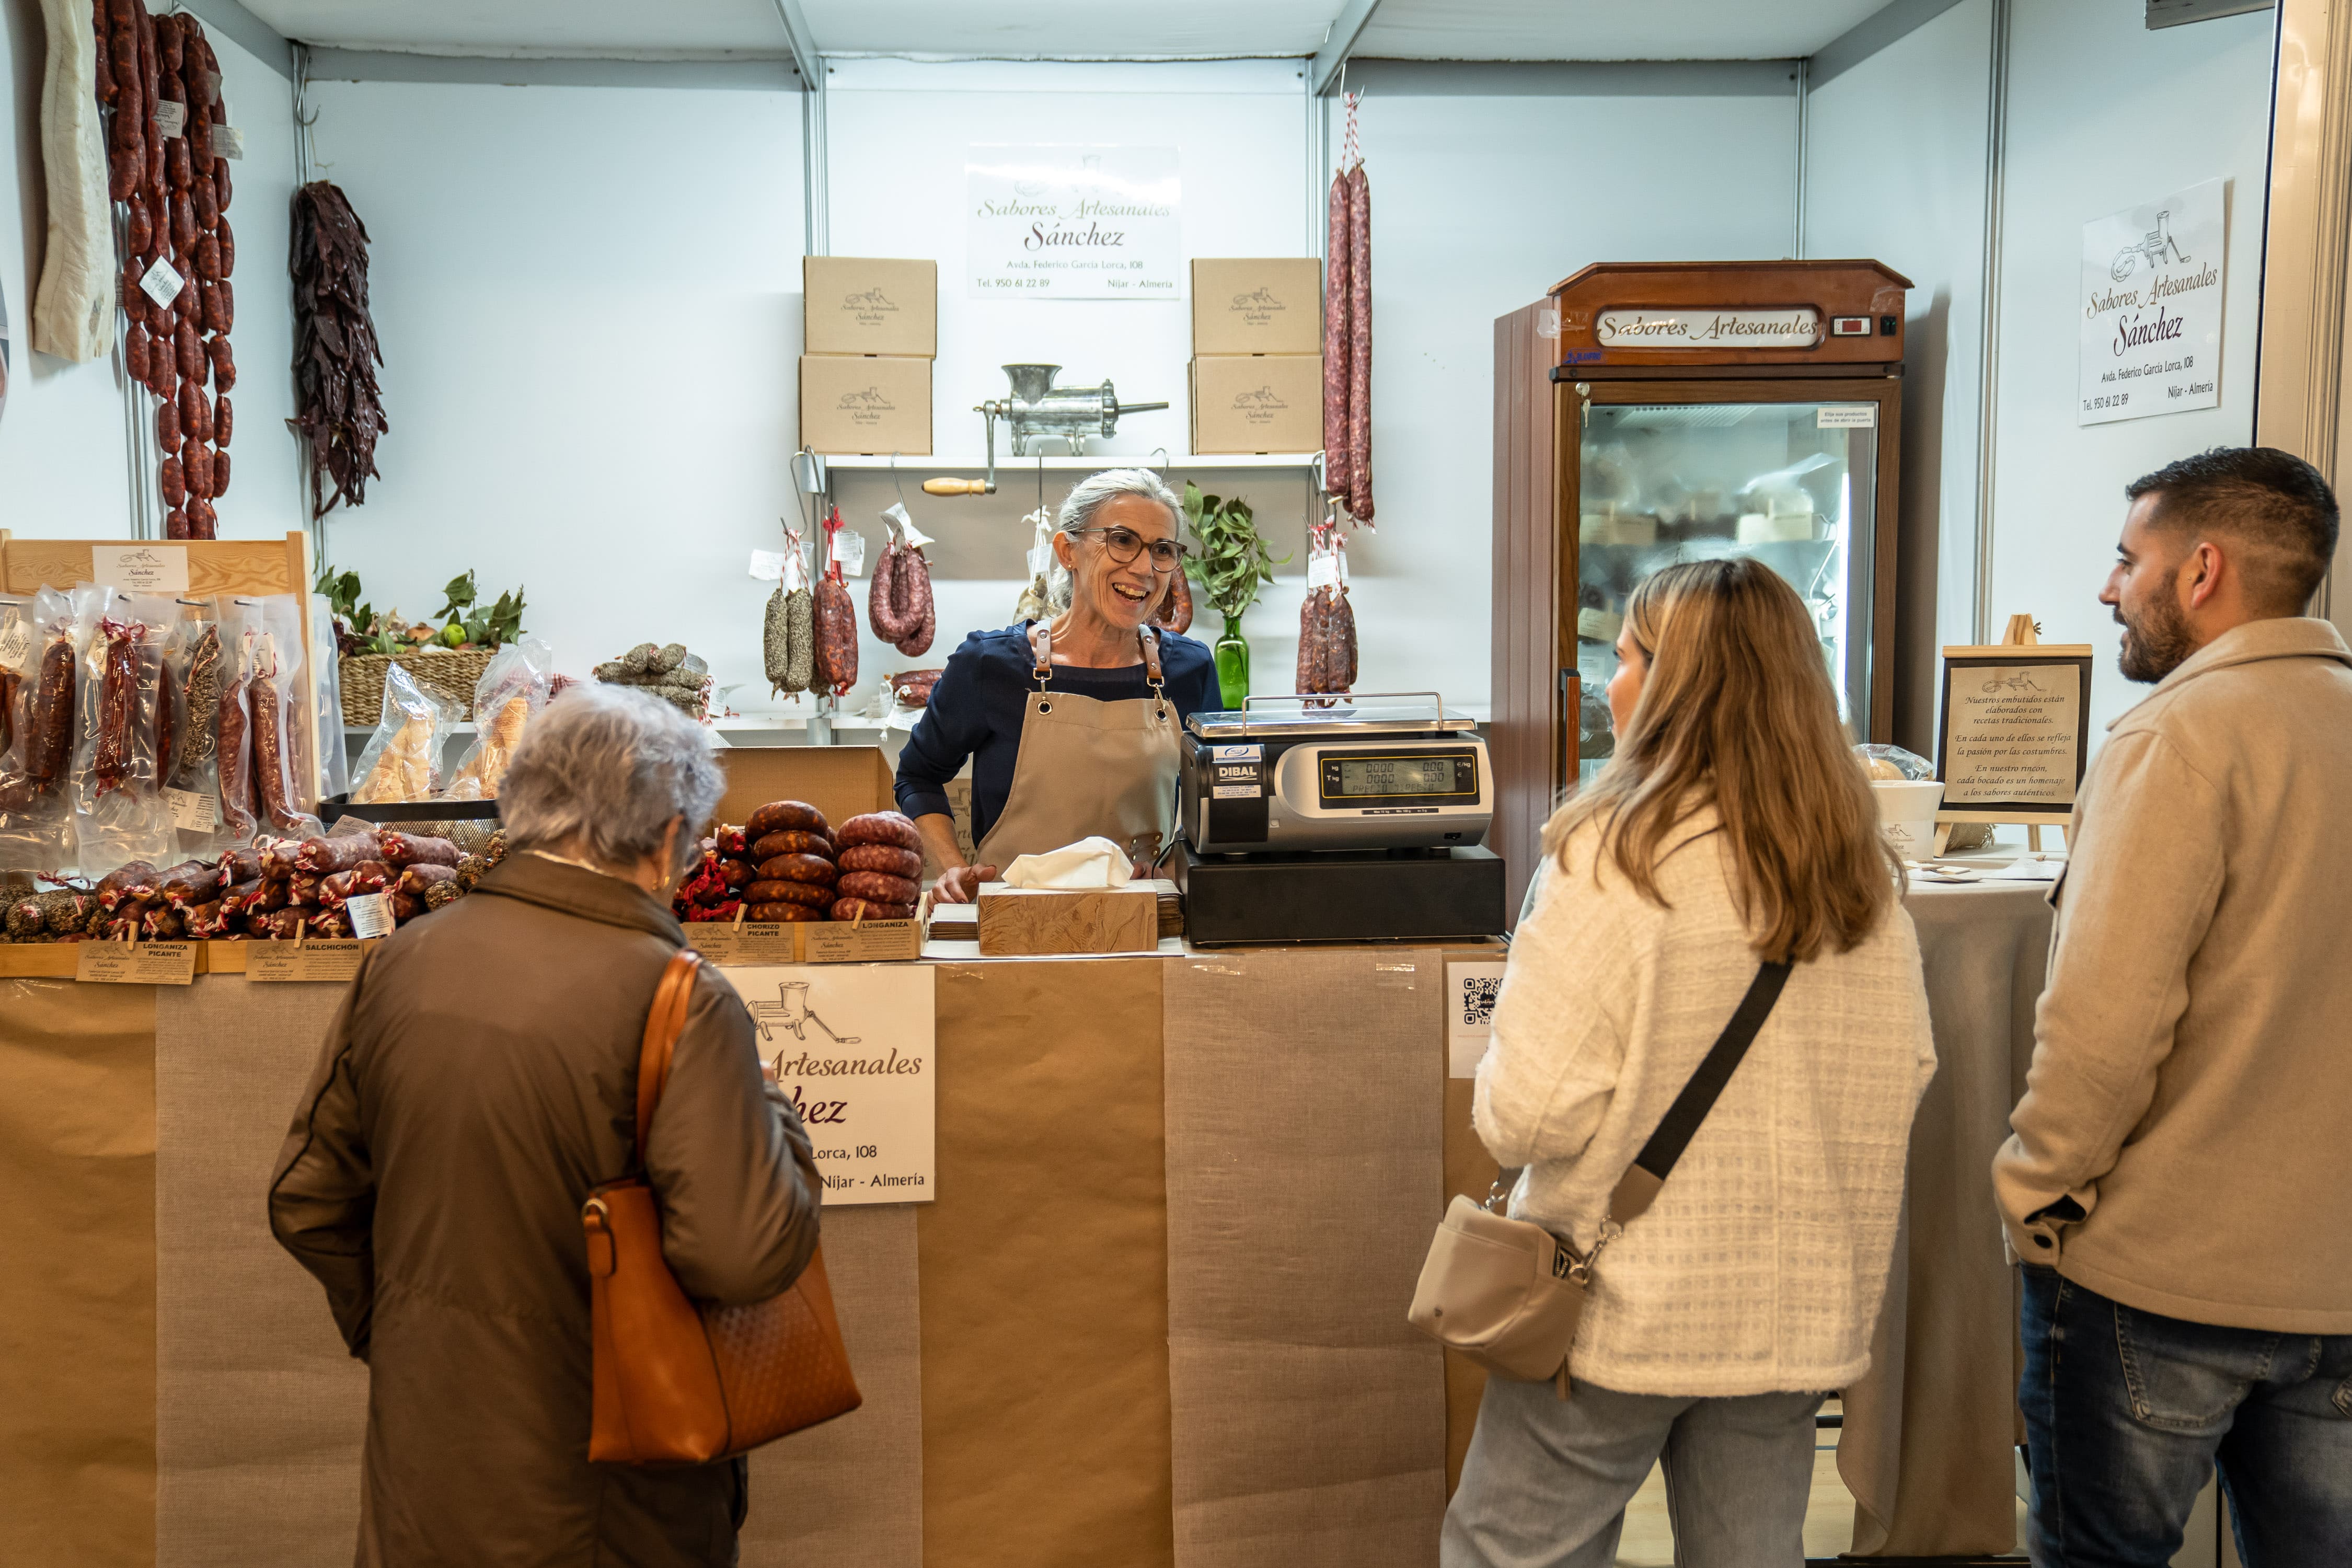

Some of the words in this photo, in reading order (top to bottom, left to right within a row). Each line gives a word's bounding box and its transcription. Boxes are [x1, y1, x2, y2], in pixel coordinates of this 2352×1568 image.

[977, 199, 1057, 219] Sabores
[1059, 198, 1170, 220] Artesanales
[1024, 221, 1125, 251] Sánchez
[1007, 260, 1030, 269] Avda.
[1034, 260, 1068, 269] Federico
[1101, 260, 1126, 270] Lorca,
[977, 279, 992, 287] Tel.
[995, 279, 1012, 287] 950
[1015, 279, 1022, 287] 61
[1027, 279, 1036, 287] 22
[1040, 279, 1050, 287] 89
[1138, 279, 1172, 288] Almería
[2086, 287, 2138, 319] Sabores
[2138, 262, 2218, 309] Artesanales
[1597, 316, 1688, 340] Sabores
[1689, 315, 1817, 340] Artesanales
[2114, 306, 2183, 356] Sánchez
[2101, 371, 2116, 383] Avda.
[2118, 367, 2141, 380] Federico
[2143, 362, 2163, 376] García
[2165, 361, 2182, 372] Lorca,
[2184, 355, 2193, 368] 108
[2083, 399, 2092, 411] Tel.
[2094, 397, 2104, 409] 950
[2105, 396, 2111, 407] 61
[2112, 394, 2119, 407] 22
[2121, 393, 2129, 405] 89
[2188, 379, 2213, 395] Almería
[2002, 716, 2054, 724] tradicionales.
[2006, 733, 2015, 742] de
[2017, 733, 2035, 742] ellos
[2047, 733, 2071, 743] refleja
[1957, 747, 1965, 755] la
[1966, 747, 1992, 757] pasión
[1993, 748, 2008, 757] por
[2009, 746, 2021, 755] las
[2022, 747, 2068, 755] costumbres.
[1219, 766, 1257, 777] DIBAL
[2021, 765, 2047, 773] rincón,
[2028, 777, 2066, 786] homenaje
[771, 1047, 923, 1082] Artesanales
[811, 1147, 850, 1160] Lorca,
[856, 1145, 877, 1158] 108
[821, 1175, 855, 1191] Níjar
[870, 1172, 925, 1187] Almería
